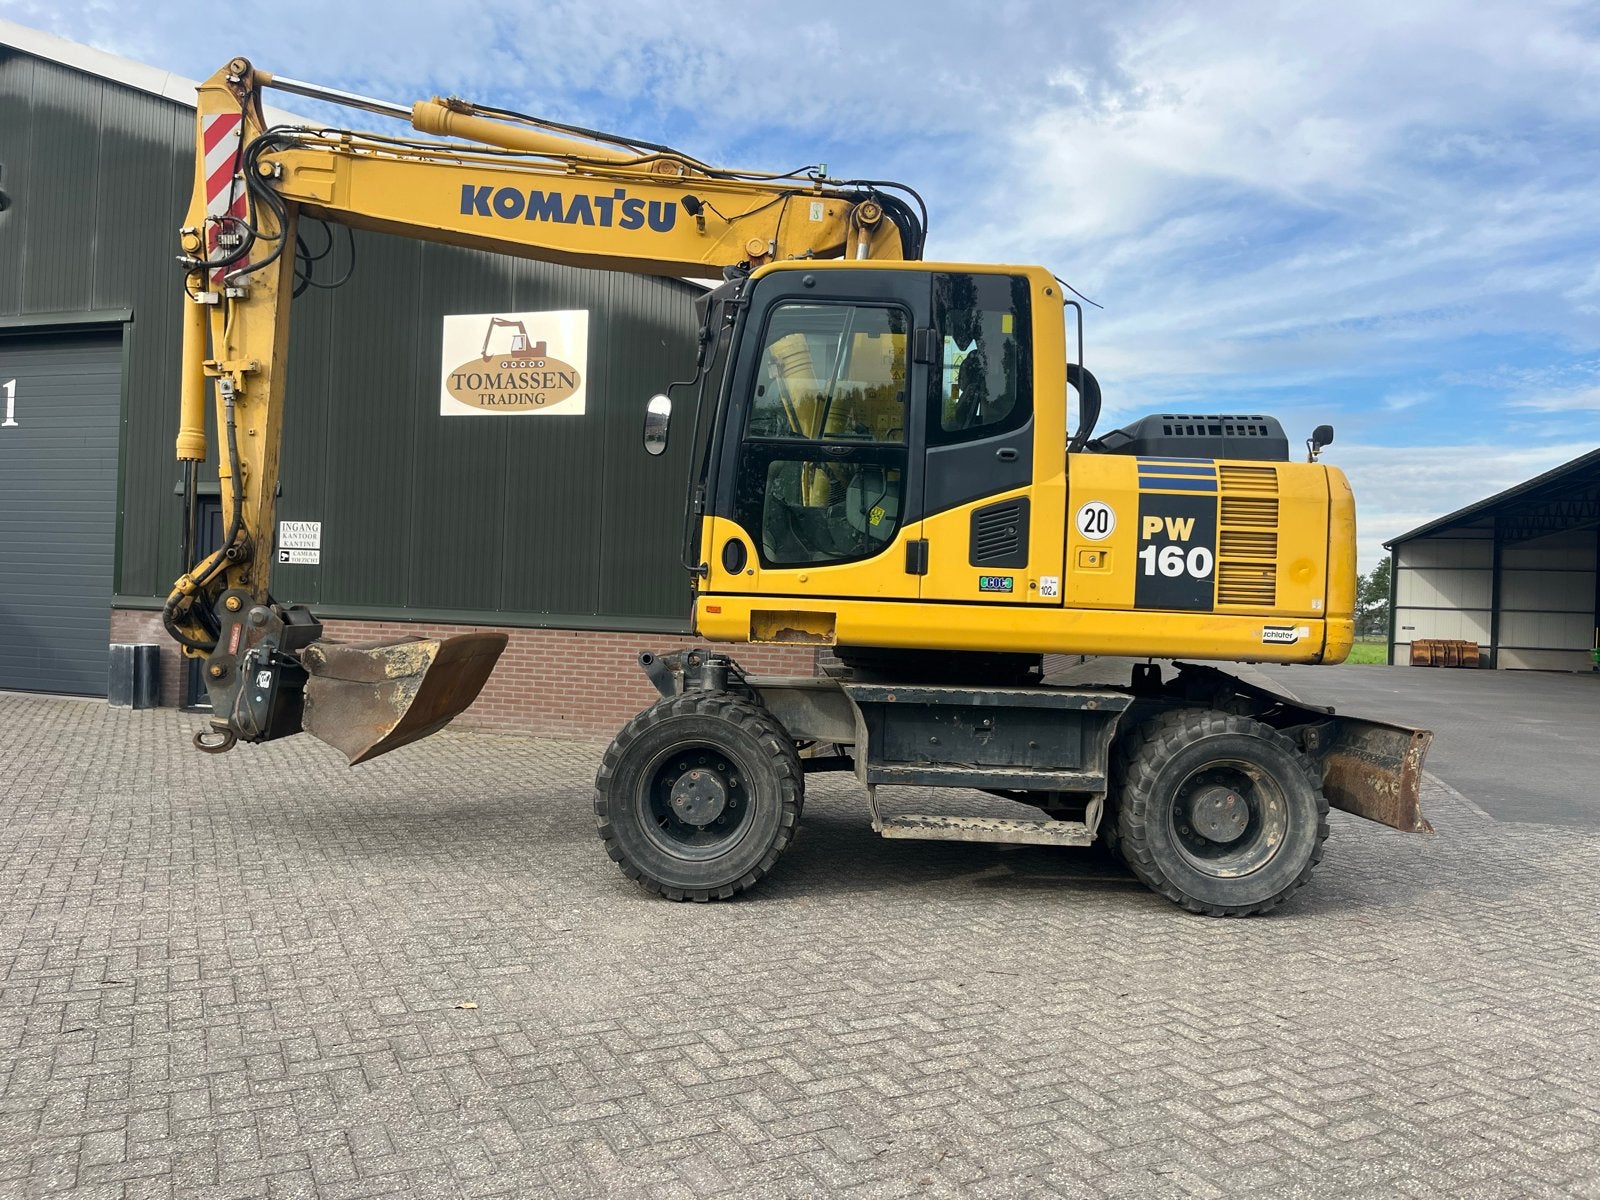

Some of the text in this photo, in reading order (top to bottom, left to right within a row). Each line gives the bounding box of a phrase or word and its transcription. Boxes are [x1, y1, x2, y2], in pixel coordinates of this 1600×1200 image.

[460, 184, 677, 233] KOMATSU
[451, 371, 576, 391] TOMASSEN
[2, 378, 19, 427] 1
[478, 392, 546, 406] TRADING
[282, 522, 319, 532] INGANG
[1083, 508, 1109, 534] 20
[1142, 515, 1196, 542] PW
[282, 532, 318, 540] KANTOOR
[283, 540, 315, 548] KANTINE
[1138, 544, 1214, 579] 160
